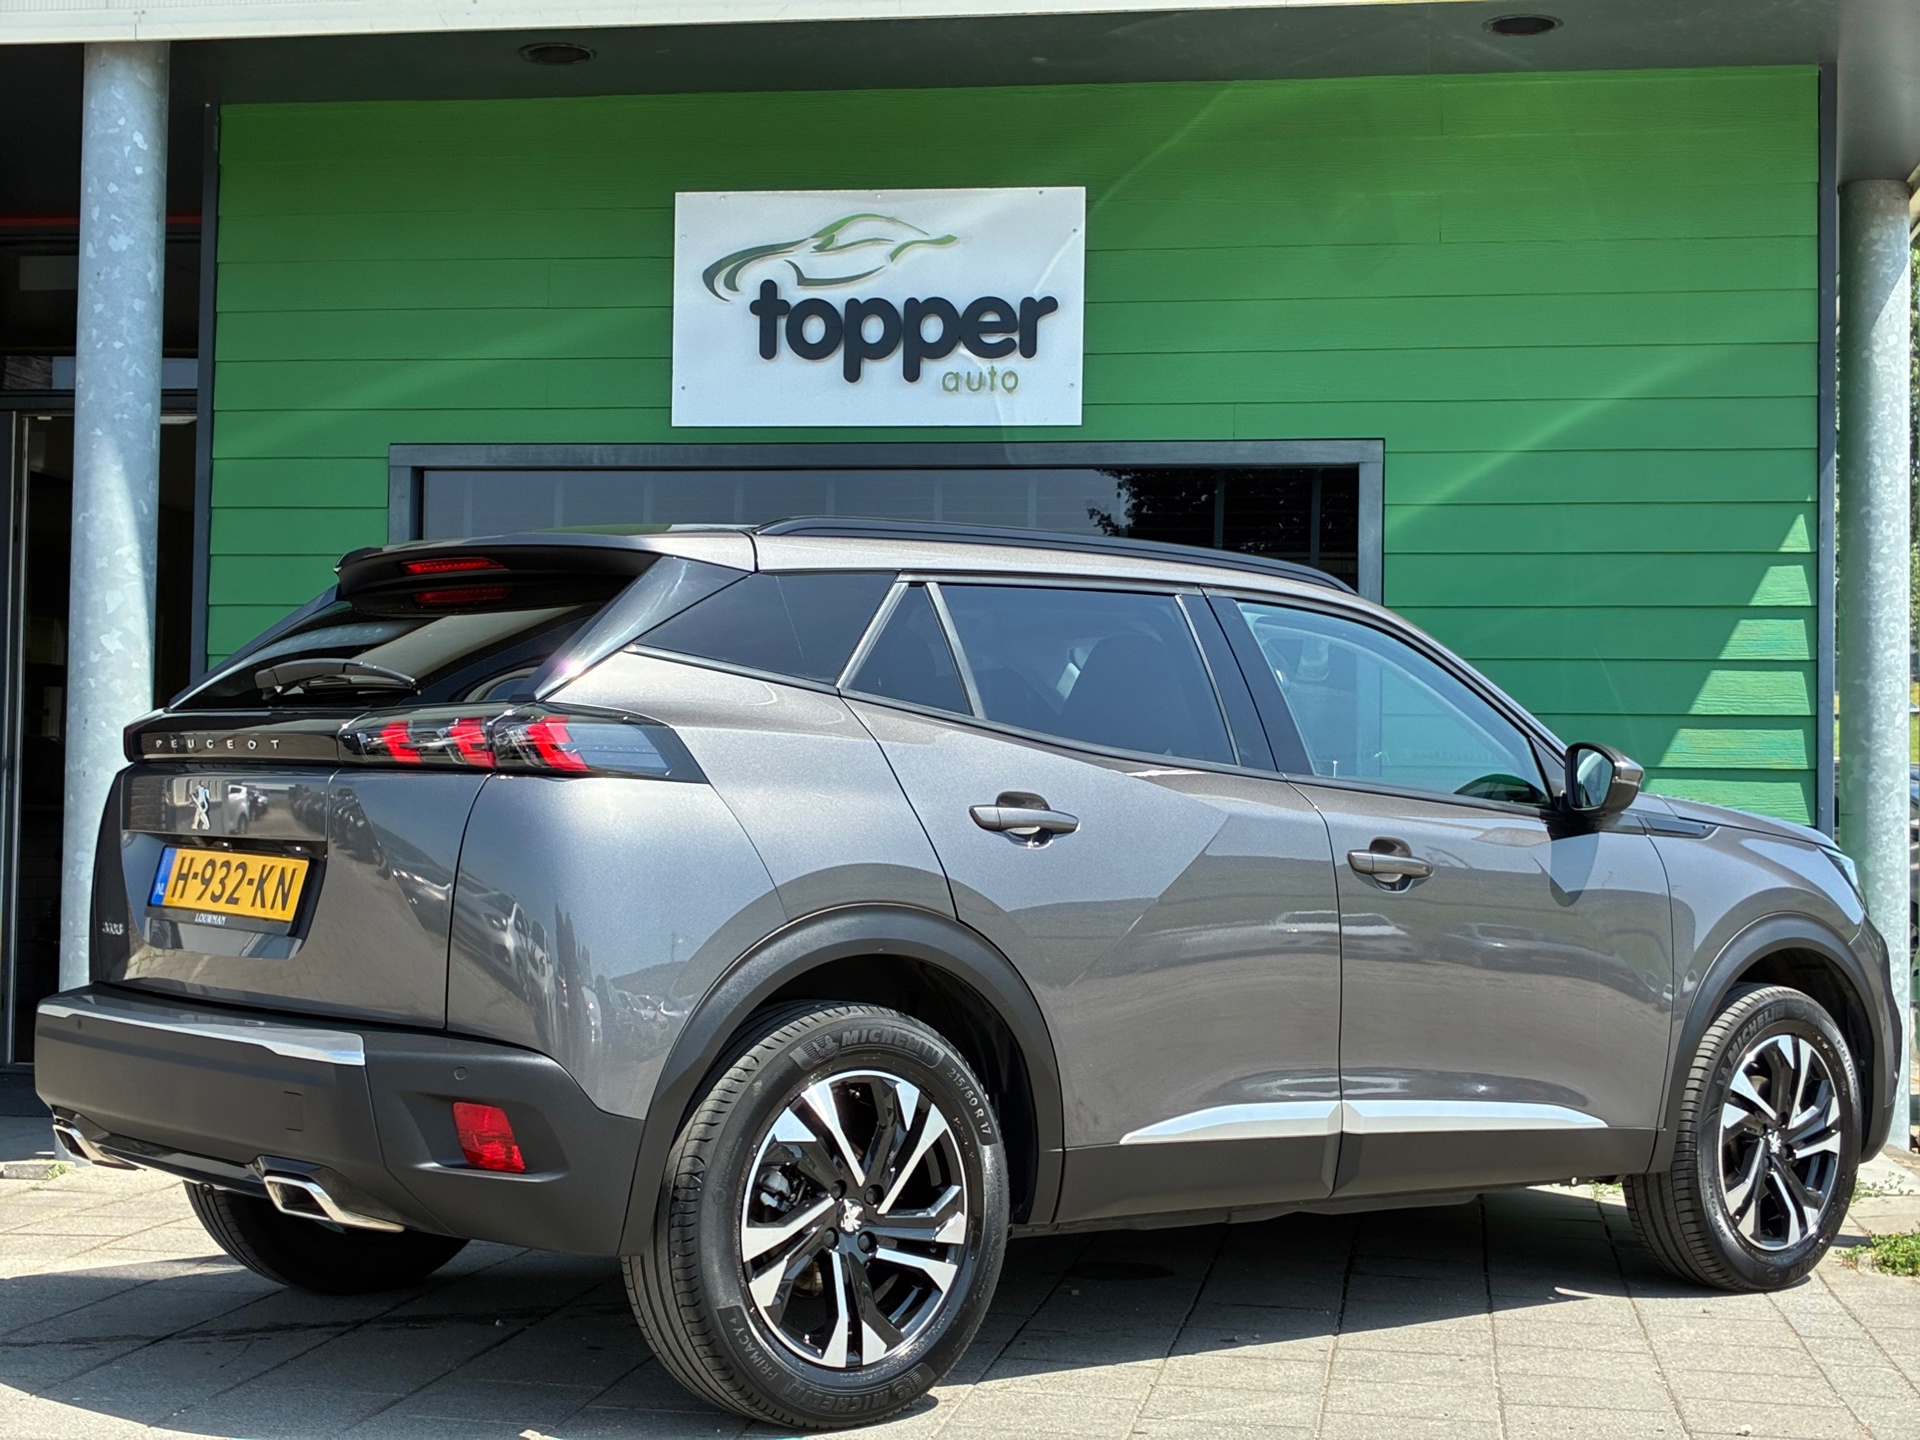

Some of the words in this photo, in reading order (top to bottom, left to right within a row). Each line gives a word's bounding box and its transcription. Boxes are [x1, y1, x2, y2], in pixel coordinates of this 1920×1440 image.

[749, 279, 1058, 383] topper
[942, 366, 1019, 393] auto
[155, 738, 280, 750] PEUGEOT
[156, 883, 165, 895] NL
[171, 856, 297, 911] H-932-KN
[195, 913, 226, 925] LOUWMAN
[841, 1029, 941, 1061] MICHELIN
[946, 1068, 979, 1106] 215/60
[974, 1108, 985, 1119] R
[980, 1122, 992, 1135] 17
[733, 1326, 778, 1381] PRIMACY
